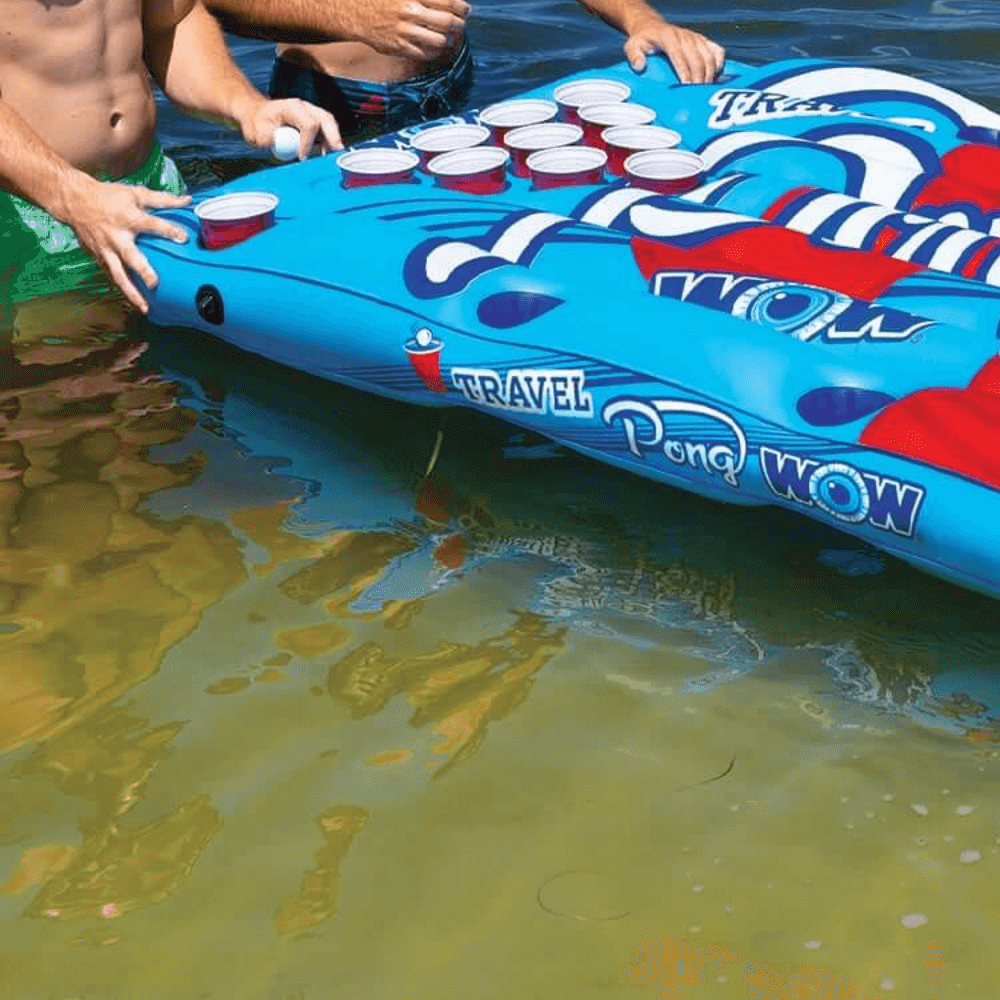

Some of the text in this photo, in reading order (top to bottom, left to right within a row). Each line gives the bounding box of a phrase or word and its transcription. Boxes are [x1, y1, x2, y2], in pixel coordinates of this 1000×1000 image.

[452, 369, 926, 537] TRAVEL Pong WOW
